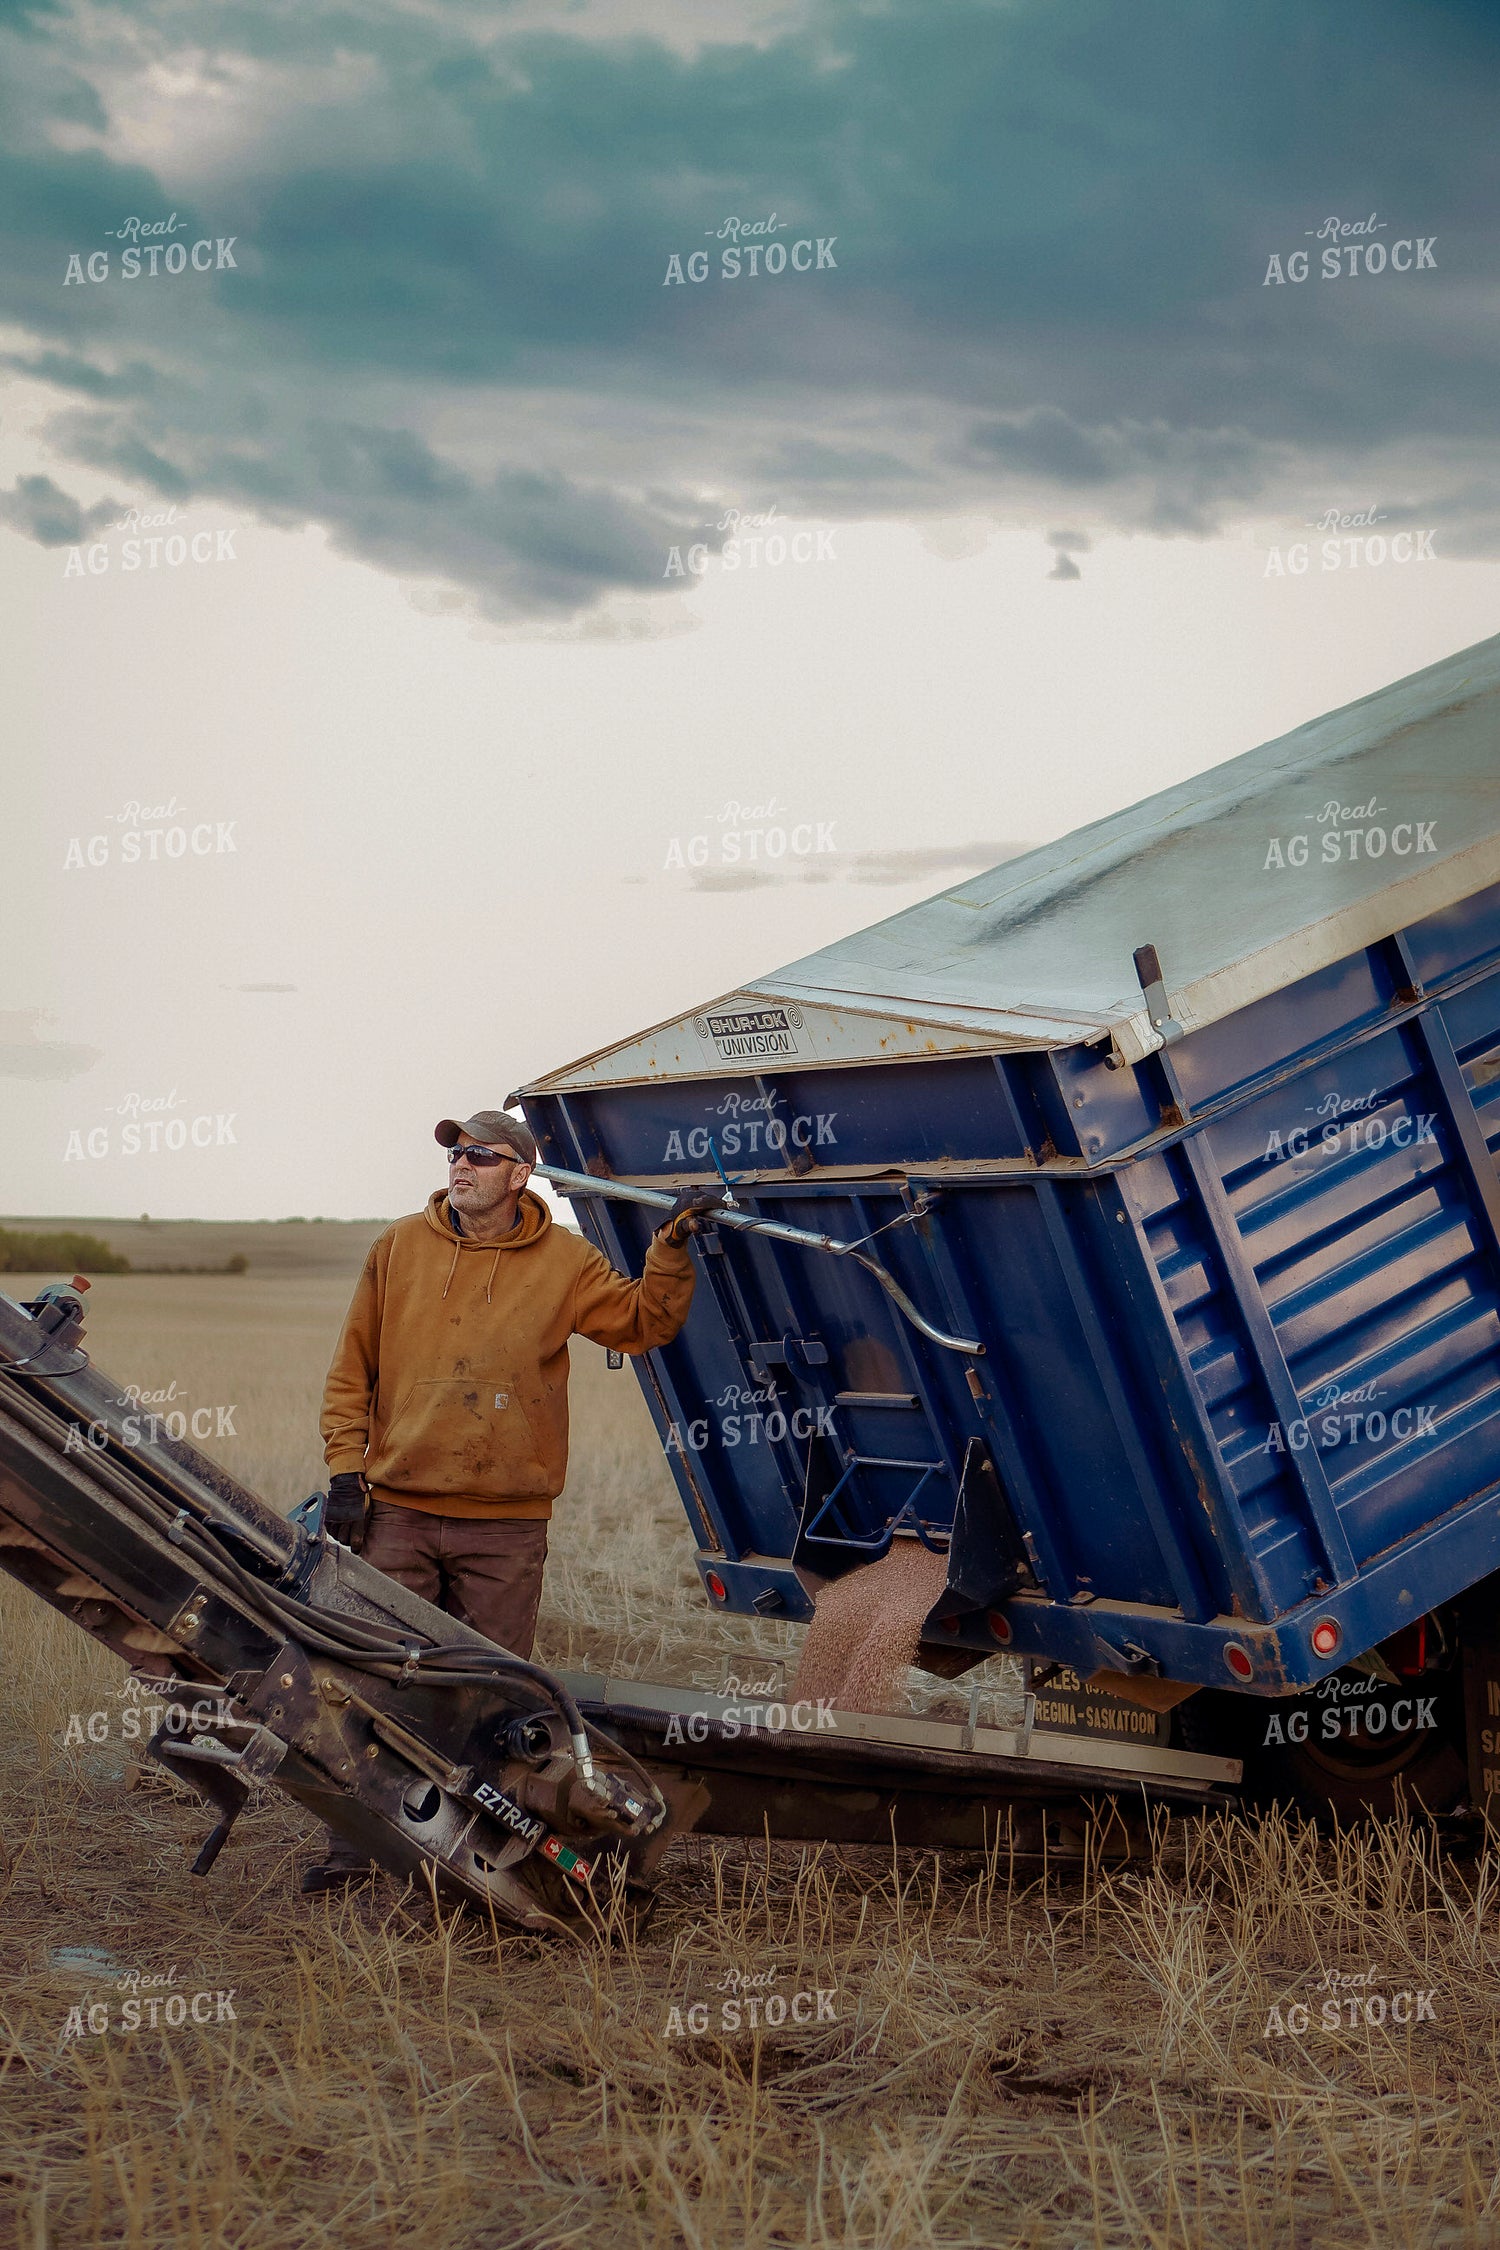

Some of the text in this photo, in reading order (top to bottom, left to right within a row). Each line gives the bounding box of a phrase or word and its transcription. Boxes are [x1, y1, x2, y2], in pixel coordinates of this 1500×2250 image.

[721, 1033, 790, 1056] UNIVISION
[1034, 1700, 1157, 1735] REGINA-SASKATOON
[472, 1782, 542, 1844] EZTRAK
